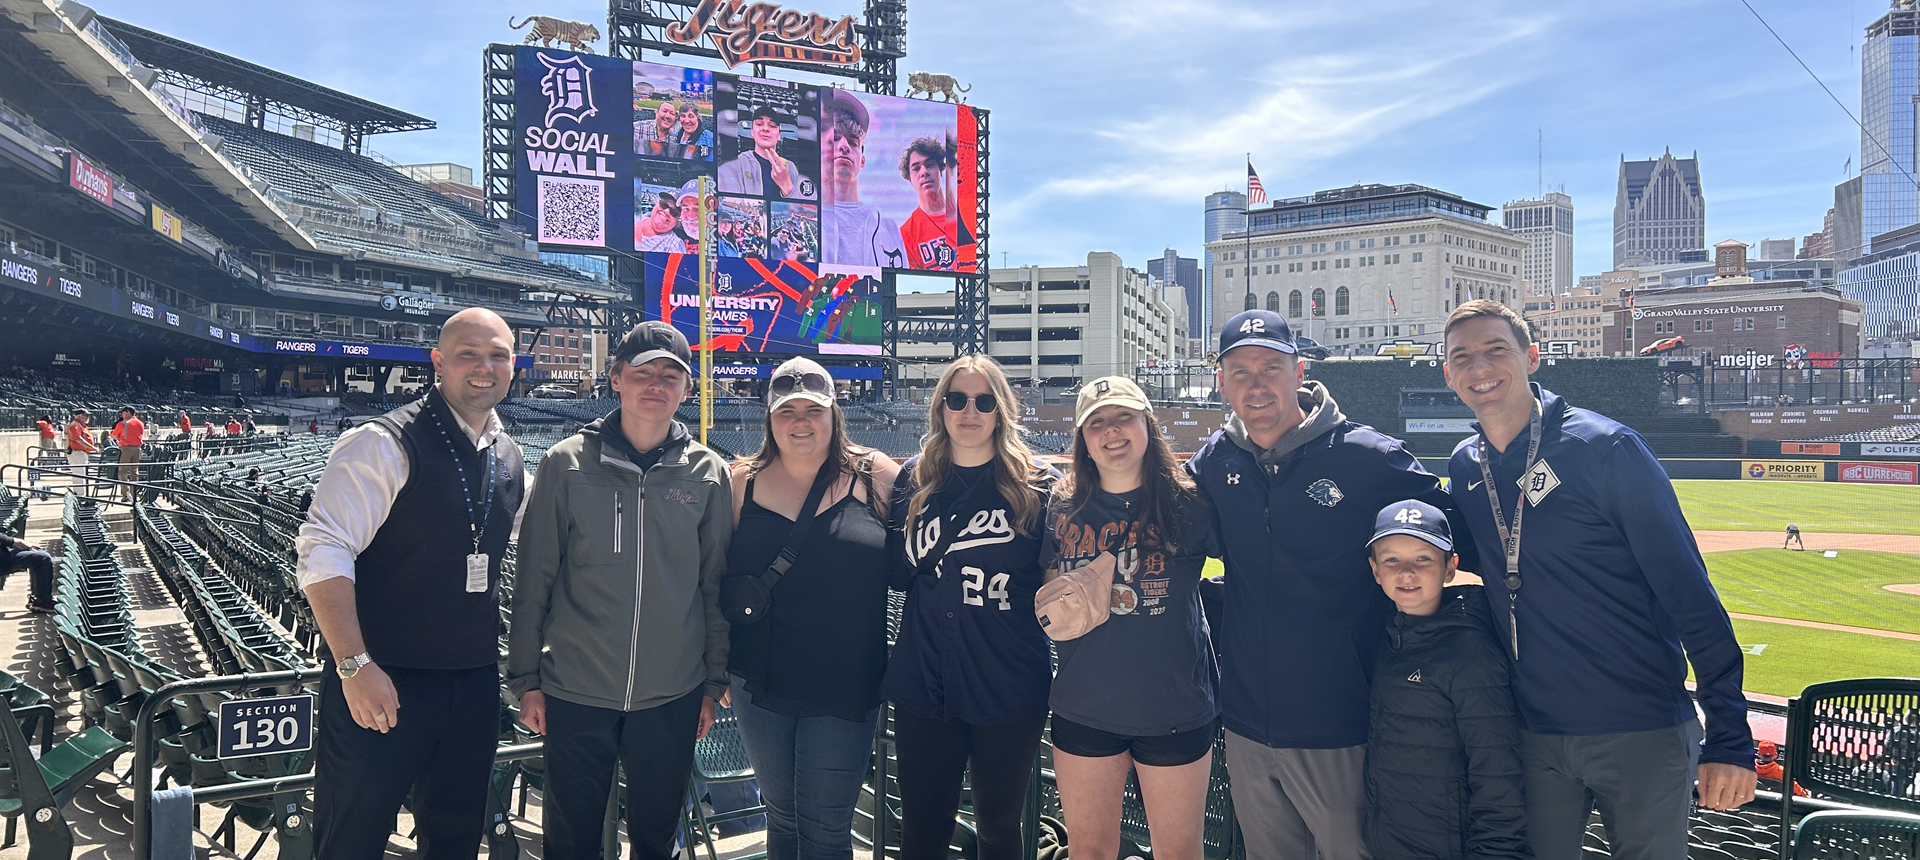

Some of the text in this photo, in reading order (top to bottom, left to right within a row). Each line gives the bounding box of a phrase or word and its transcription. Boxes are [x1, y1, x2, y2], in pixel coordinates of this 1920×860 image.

[525, 126, 615, 155] SOCIAL
[526, 150, 615, 178] WALL
[76, 159, 108, 196] Dunham's
[705, 180, 718, 273] ROCKET
[1, 259, 37, 285] RANGERS
[1609, 275, 1630, 285] Ashley
[59, 277, 81, 298] TIGERS
[398, 296, 435, 310] Gallagher
[669, 294, 779, 311] UNIVERSITY
[131, 301, 154, 320] RANGERS
[404, 308, 430, 317] INSURANCE
[705, 310, 748, 322] GAMES
[1673, 308, 1703, 316] VALLEY
[1703, 307, 1730, 315] STATE
[1730, 304, 1785, 314] UNIVERSITY
[166, 311, 180, 327] TIGERS
[1239, 318, 1265, 334] 42
[275, 340, 317, 352] RANGERS
[342, 345, 370, 355] TIGERS
[1720, 351, 1775, 370] meijer
[1807, 351, 1840, 360] BELLE
[1140, 359, 1185, 368] ROCKET
[1811, 360, 1836, 368] TIRE
[551, 368, 584, 380] MARKET
[713, 366, 758, 376] RANGERS
[1026, 407, 1036, 416] 23
[1182, 411, 1190, 419] 16
[1903, 405, 1912, 413] 11
[1162, 426, 1168, 434] 3
[1207, 427, 1211, 435] 1
[1768, 464, 1818, 473] PRIORITY
[1844, 467, 1912, 481] ABC WAREHOUSE
[1394, 508, 1422, 525] 42
[961, 566, 1012, 611] 24
[1140, 581, 1170, 589] DETROIT
[236, 703, 297, 718] SECTION
[232, 716, 299, 751] 130
[38, 810, 50, 821] 35
